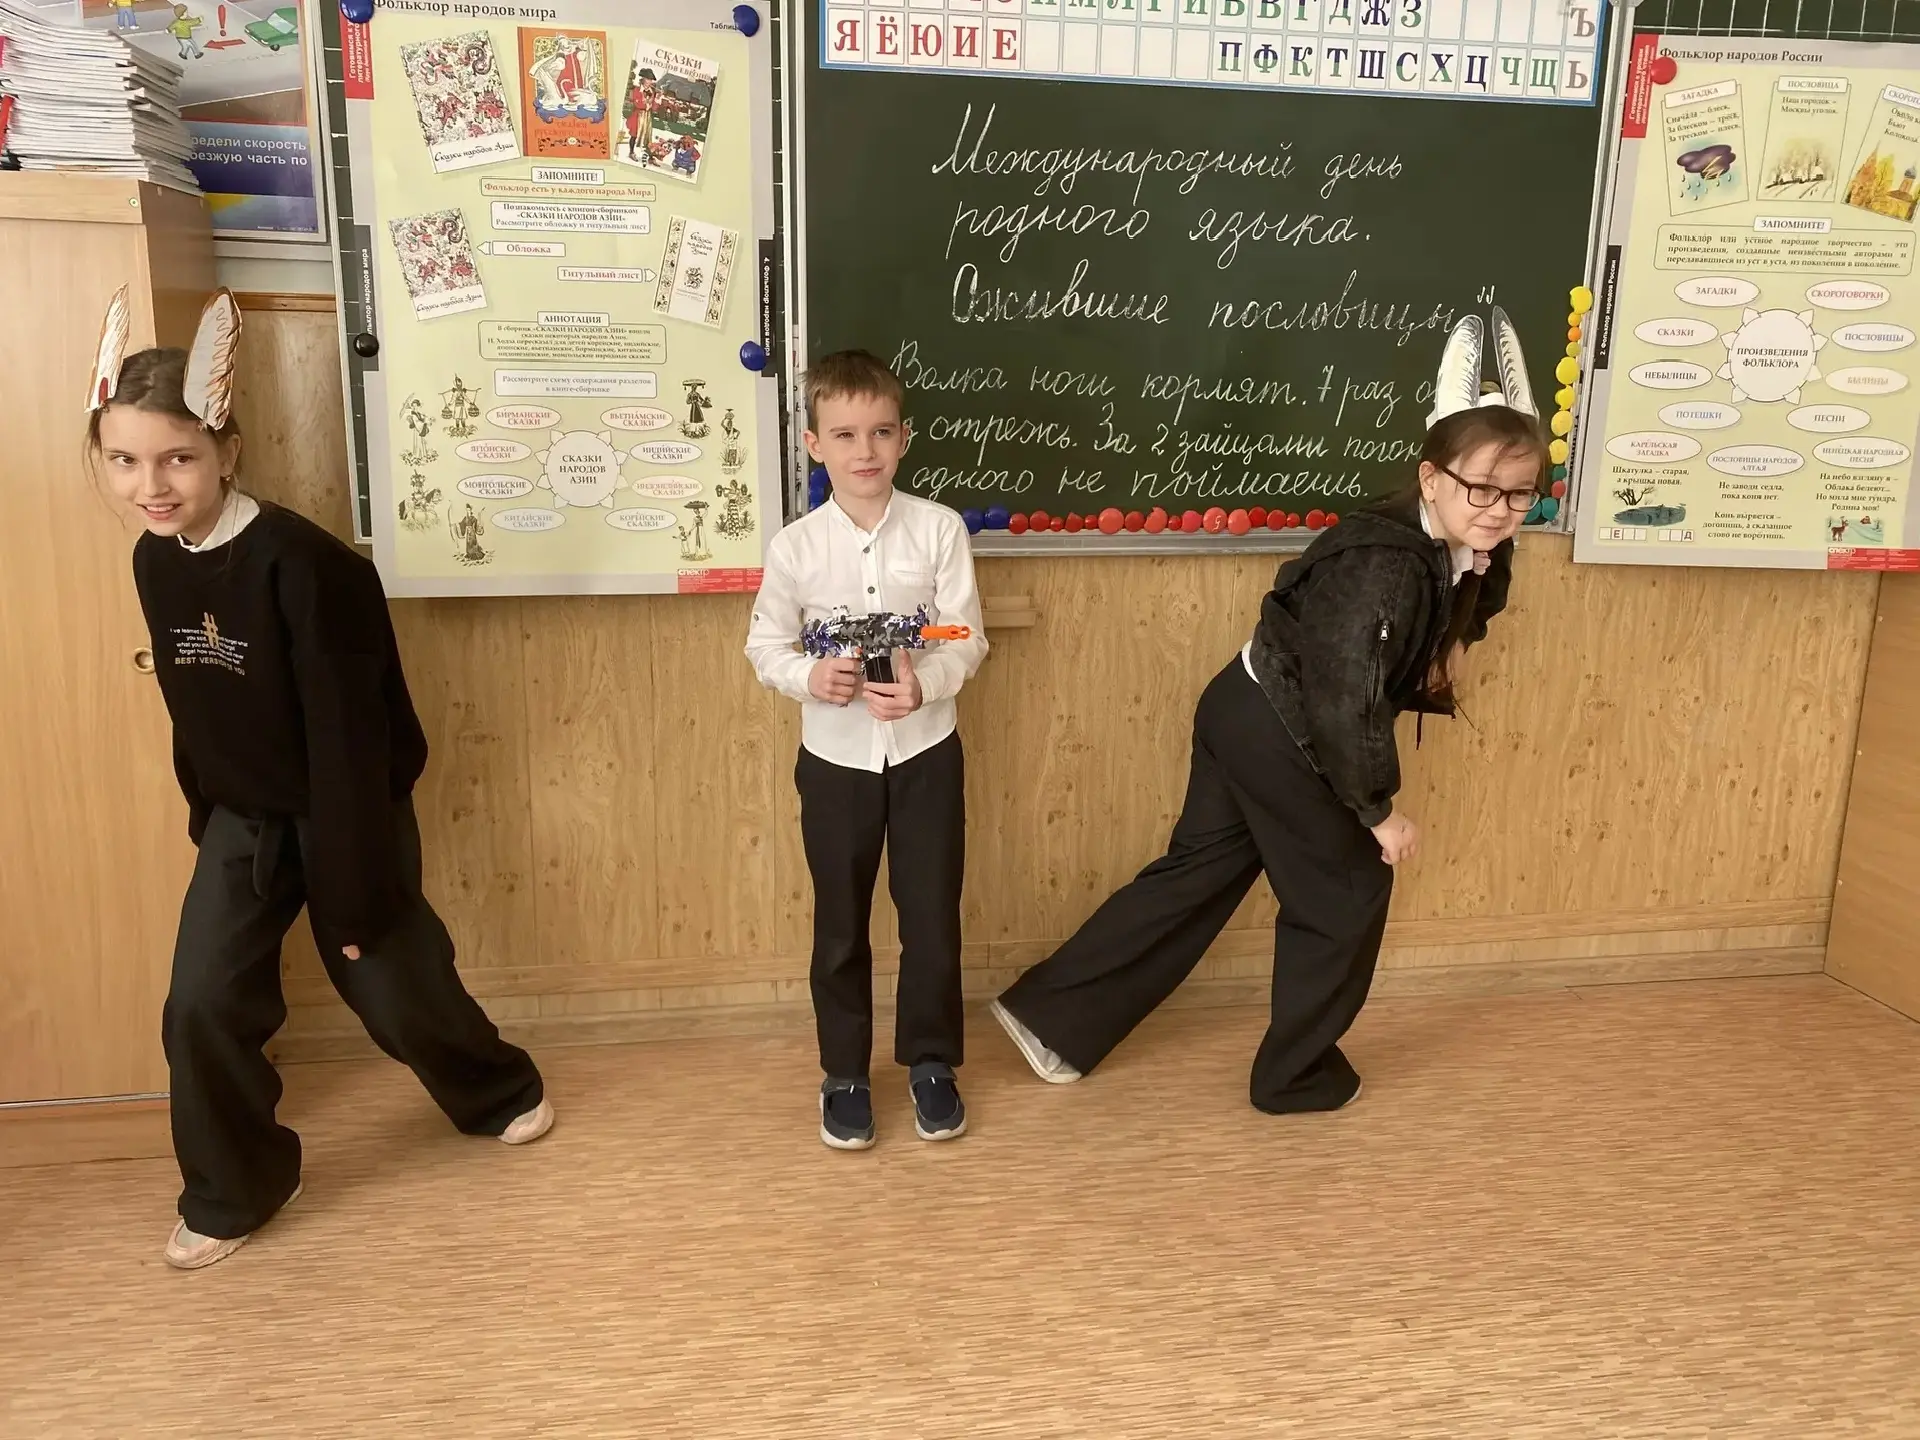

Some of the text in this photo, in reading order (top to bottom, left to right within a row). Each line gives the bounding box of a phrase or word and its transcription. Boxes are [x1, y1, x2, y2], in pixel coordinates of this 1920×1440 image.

[454, 4, 516, 17] народов
[519, 9, 557, 21] мира
[709, 21, 740, 31] Таблиц
[655, 48, 703, 70] СКАЗКИ
[834, 15, 1588, 95] Я Ё Ю И Е П Ф К Т Ш С Х Ц Ч Щ Ь
[1659, 48, 1823, 64] Фольклор народов России
[1788, 80, 1839, 90] ПОСЛОВИЦА
[1681, 87, 1719, 101] ЗАГАДКА
[191, 137, 307, 151] редели скорость
[190, 151, 308, 166] оезжую часть по
[932, 102, 1403, 205] Международный день
[537, 170, 599, 182] ЗАПОМНИТЕ!
[484, 183, 529, 194] Фольклор
[558, 187, 594, 195] каждого
[596, 189, 625, 197] народа
[557, 212, 598, 221] НАРОДОВ
[1761, 219, 1825, 230] ЗАПОМНИТЕ!
[945, 201, 1371, 269] родного языка.
[506, 243, 551, 254] Обложка
[561, 268, 640, 280] Титульный лист
[951, 259, 1170, 325] Ожившие
[1696, 286, 1737, 296] ЗАГАДКИ
[1811, 289, 1884, 300] СКОРОГОВОРКИ
[544, 315, 602, 324] АННОТАЦИЯ
[1657, 327, 1694, 337] СКАЗКИ
[1844, 332, 1905, 343] ПОСЛОВИЦЫ
[1736, 347, 1809, 358] ПРОИЗВЕДЕНИЯ
[1742, 358, 1800, 369] ФОЛЬКЛОРА
[1644, 370, 1698, 381] НЕБЫЛИЦЫ
[890, 339, 1008, 393] Волка
[1141, 367, 1307, 425] кормят.
[1336, 376, 1402, 428] раз
[1675, 410, 1722, 420] ПОТЕШКИ
[1813, 414, 1846, 423] ПЕСНИ
[507, 418, 541, 426] СКАЗКИ
[622, 419, 655, 427] СКАЗКИ
[1093, 402, 1137, 454] За
[1171, 423, 1330, 473] зайцами
[1343, 435, 1424, 463] погон
[562, 454, 602, 463] СКАЗКИ
[559, 465, 606, 474] НАРОДОВ
[569, 476, 597, 485] АЗИИ
[911, 463, 1369, 501] одного не поймаешь.
[652, 488, 684, 496] СКАЗКИ
[174, 656, 197, 665] BEST
